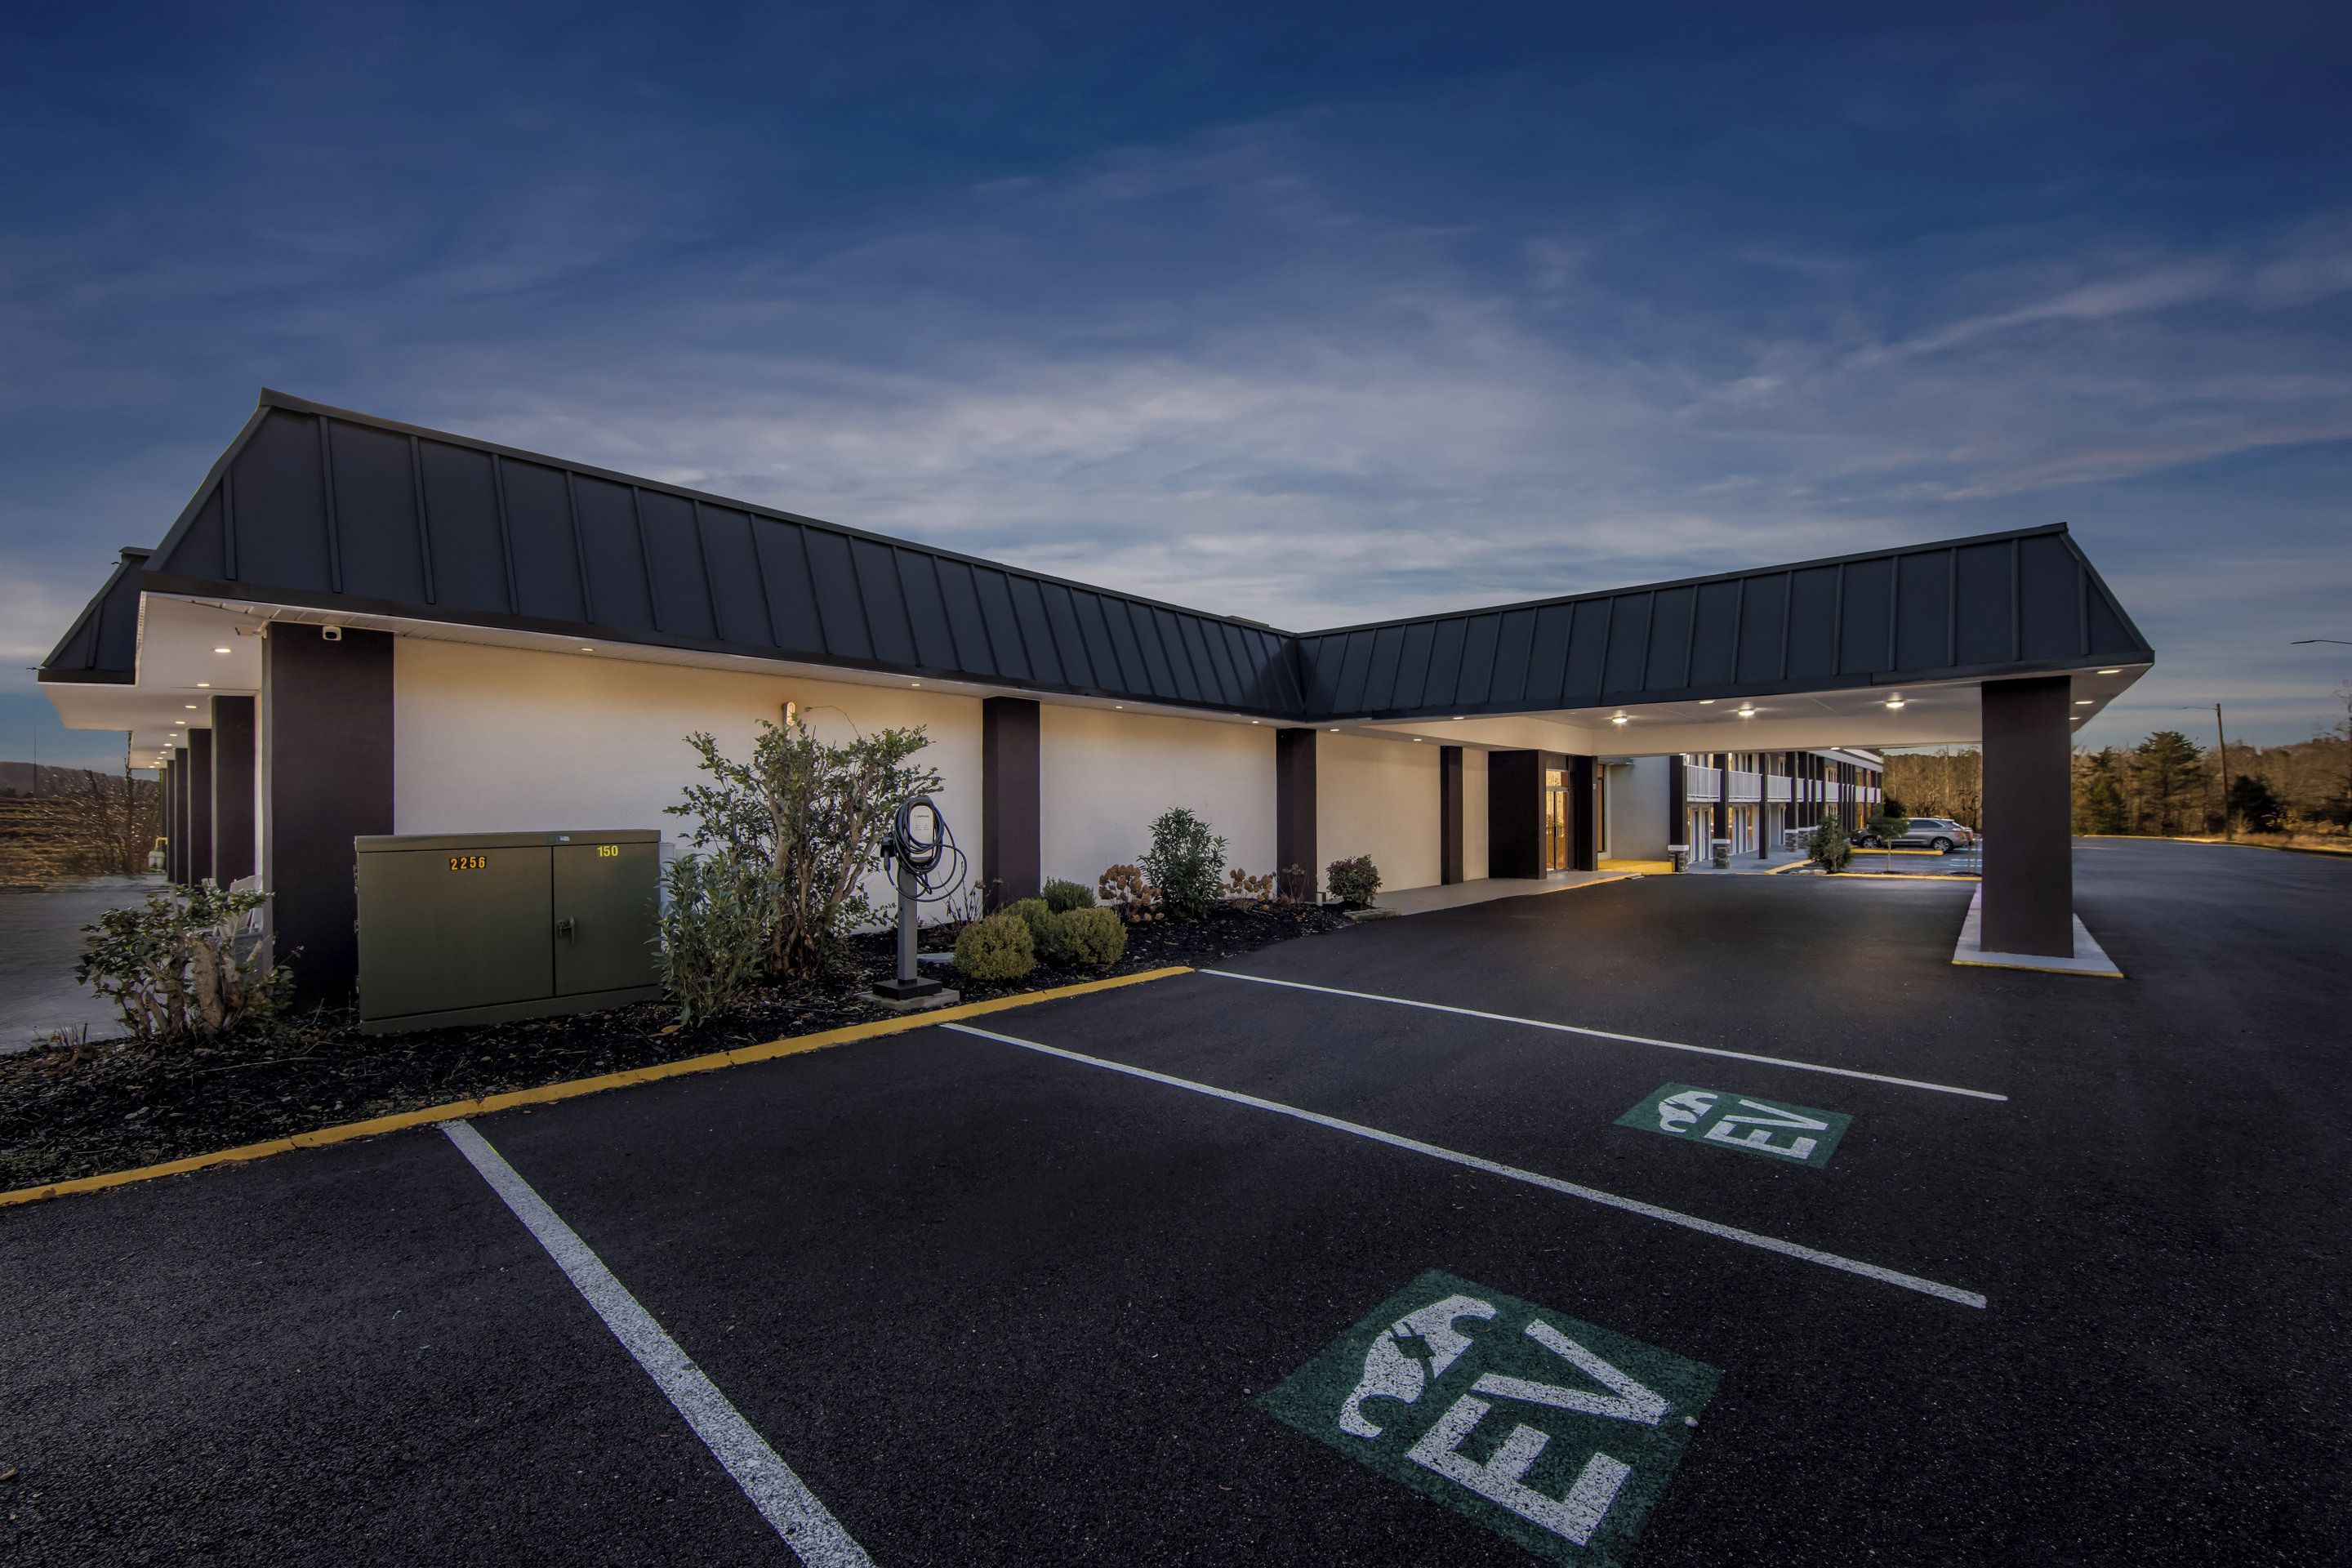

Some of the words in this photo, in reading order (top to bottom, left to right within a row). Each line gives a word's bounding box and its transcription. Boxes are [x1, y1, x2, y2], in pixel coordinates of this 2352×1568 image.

[451, 857, 485, 870] 2256
[597, 845, 618, 857] 150
[1704, 1098, 1829, 1160] EV
[1406, 1318, 1670, 1547] EV
